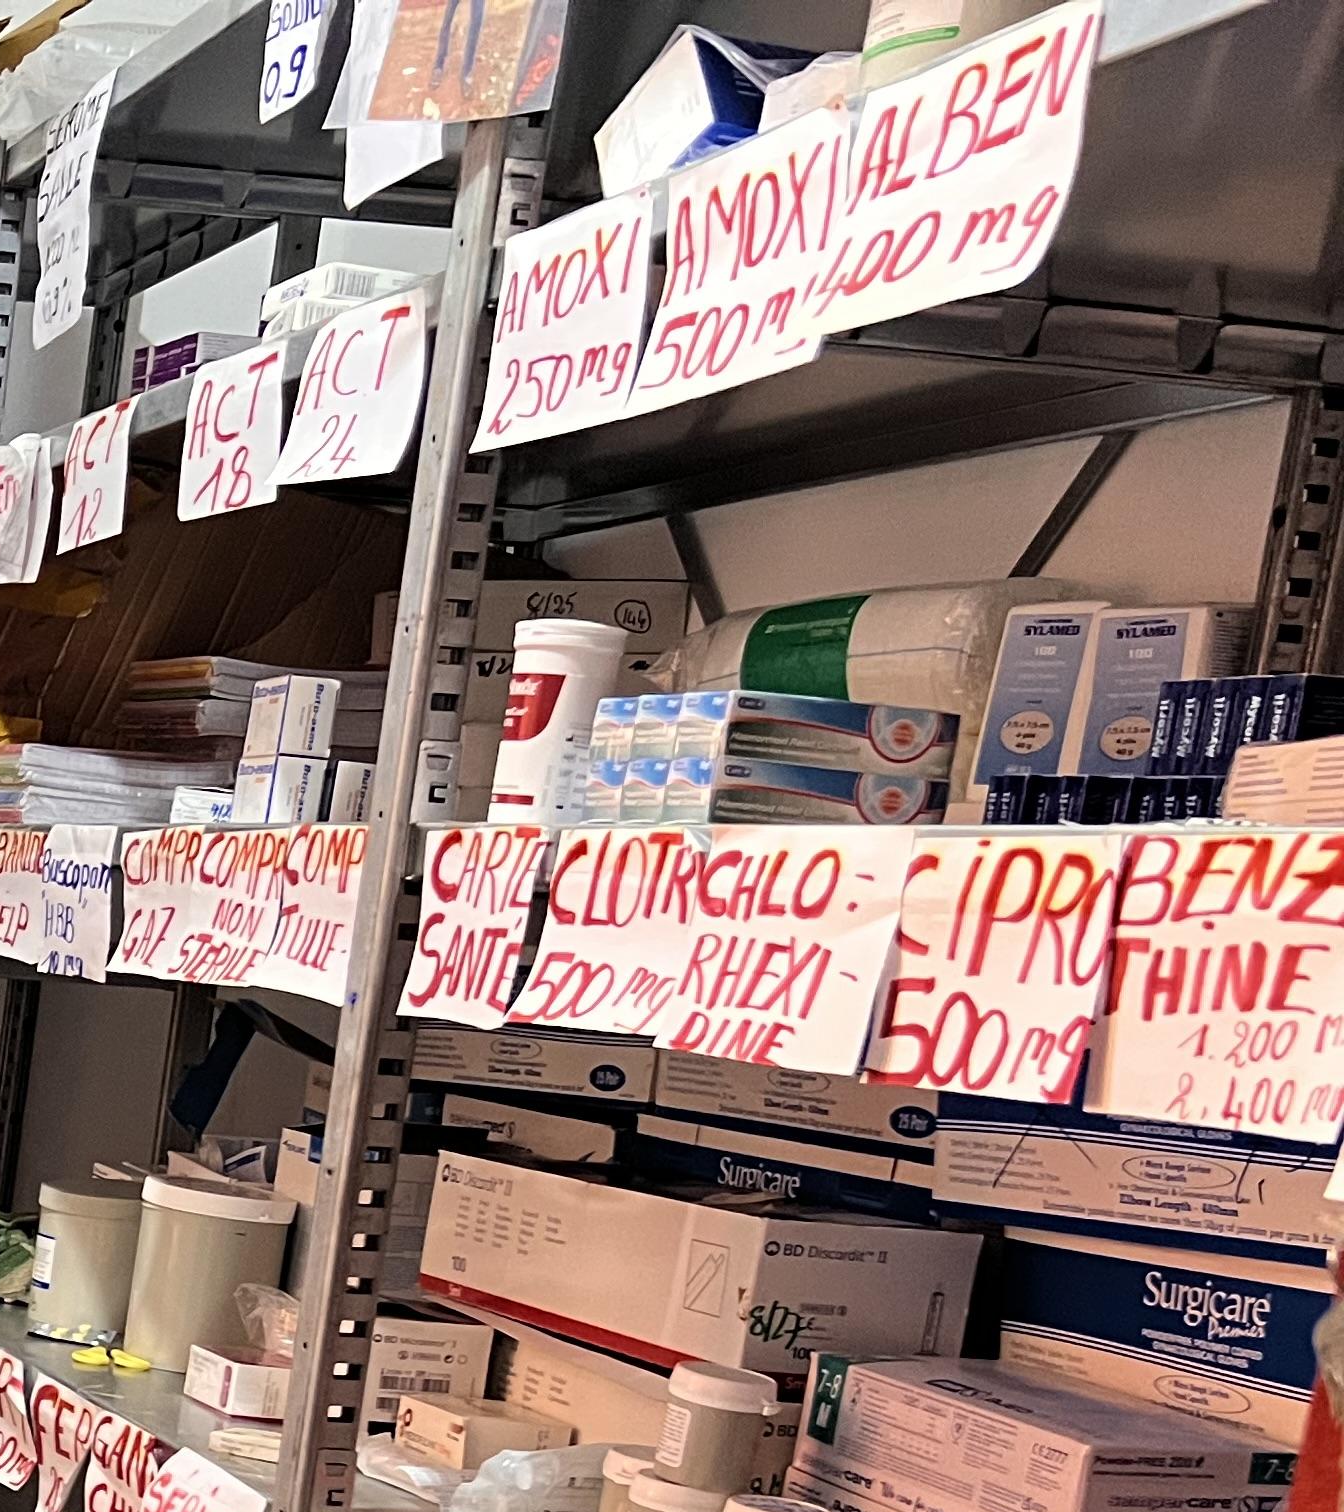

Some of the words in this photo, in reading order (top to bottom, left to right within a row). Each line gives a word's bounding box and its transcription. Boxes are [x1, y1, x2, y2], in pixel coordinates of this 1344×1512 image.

[264, 44, 308, 107] 0,9
[847, 14, 1095, 214] ALBEN
[663, 136, 843, 306] AMOXI
[812, 210, 941, 318] 400
[950, 185, 1058, 274] mg
[498, 217, 641, 342] AMOXI
[296, 306, 412, 416] ACT
[488, 353, 575, 436] 250
[577, 341, 633, 396] mg
[639, 306, 749, 390] 500
[63, 401, 129, 484] ACT
[188, 352, 279, 461] ACT
[287, 413, 358, 480] 24
[65, 486, 103, 549] 12
[193, 445, 252, 513] 18
[42, 848, 113, 895] Buscopan
[431, 828, 551, 909] CARTE
[211, 897, 264, 943] NON
[897, 840, 1116, 987] CIPRO
[510, 951, 615, 1023] 500
[1106, 922, 1331, 1022] THINE
[667, 1011, 796, 1067] DINE
[866, 976, 1010, 1090] 500
[1009, 1014, 1096, 1104] mg
[717, 1155, 801, 1198] Surgicare
[783, 1241, 804, 1257] BD
[1143, 1271, 1271, 1327] Surgicare
[817, 1368, 843, 1397] 7-8
